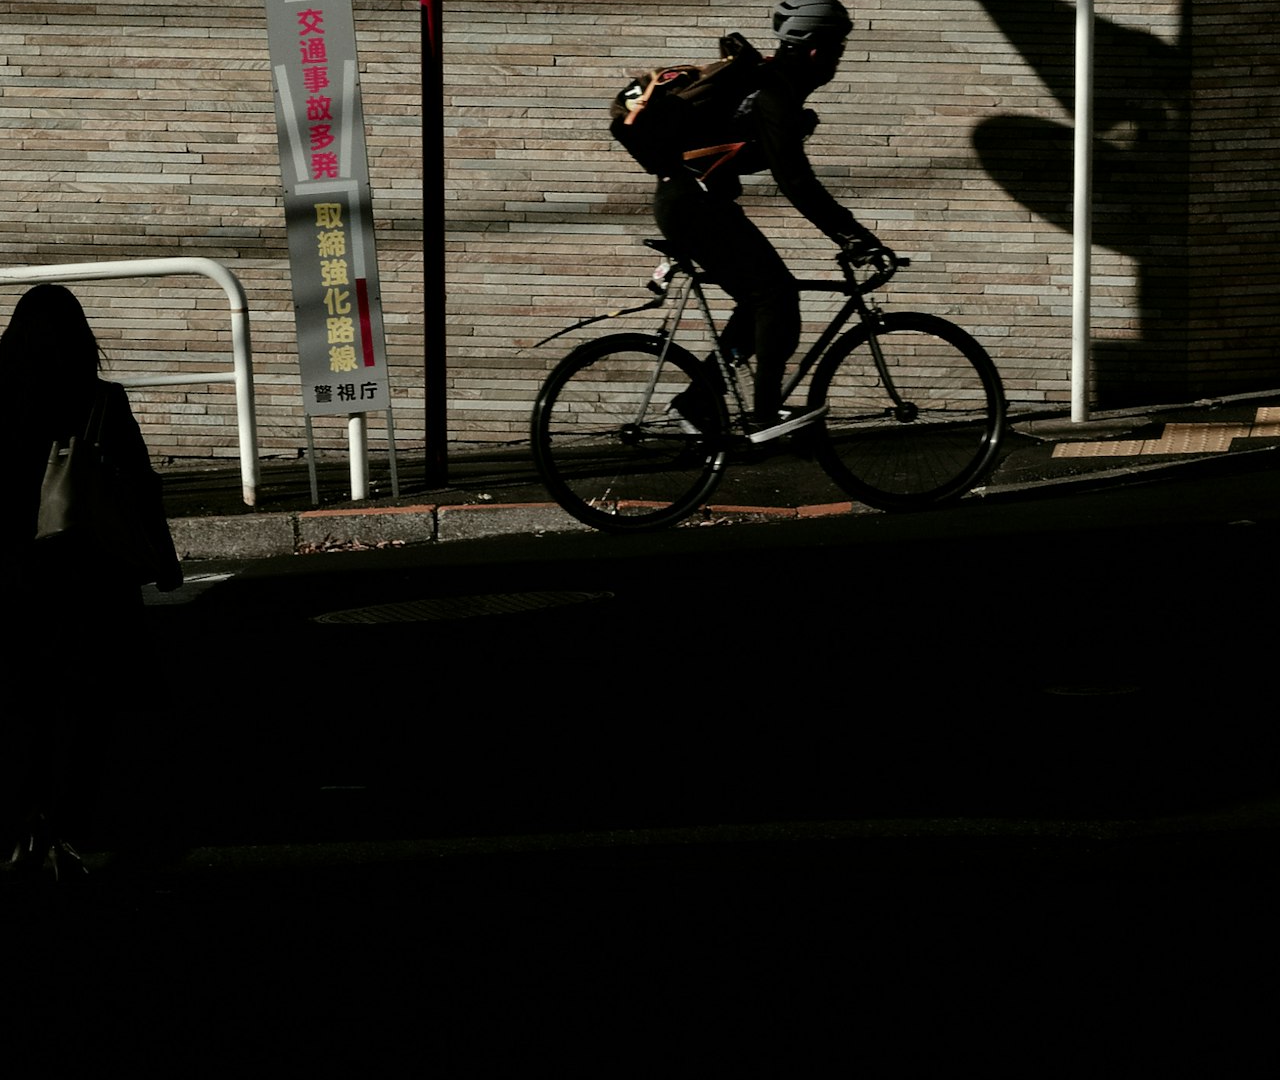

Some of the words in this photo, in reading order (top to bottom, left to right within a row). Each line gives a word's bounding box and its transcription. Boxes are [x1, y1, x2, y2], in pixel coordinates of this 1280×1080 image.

[296, 8, 338, 179] 交通事故多発
[314, 203, 358, 374] 取締強化路線
[314, 381, 379, 403] 警視庁
